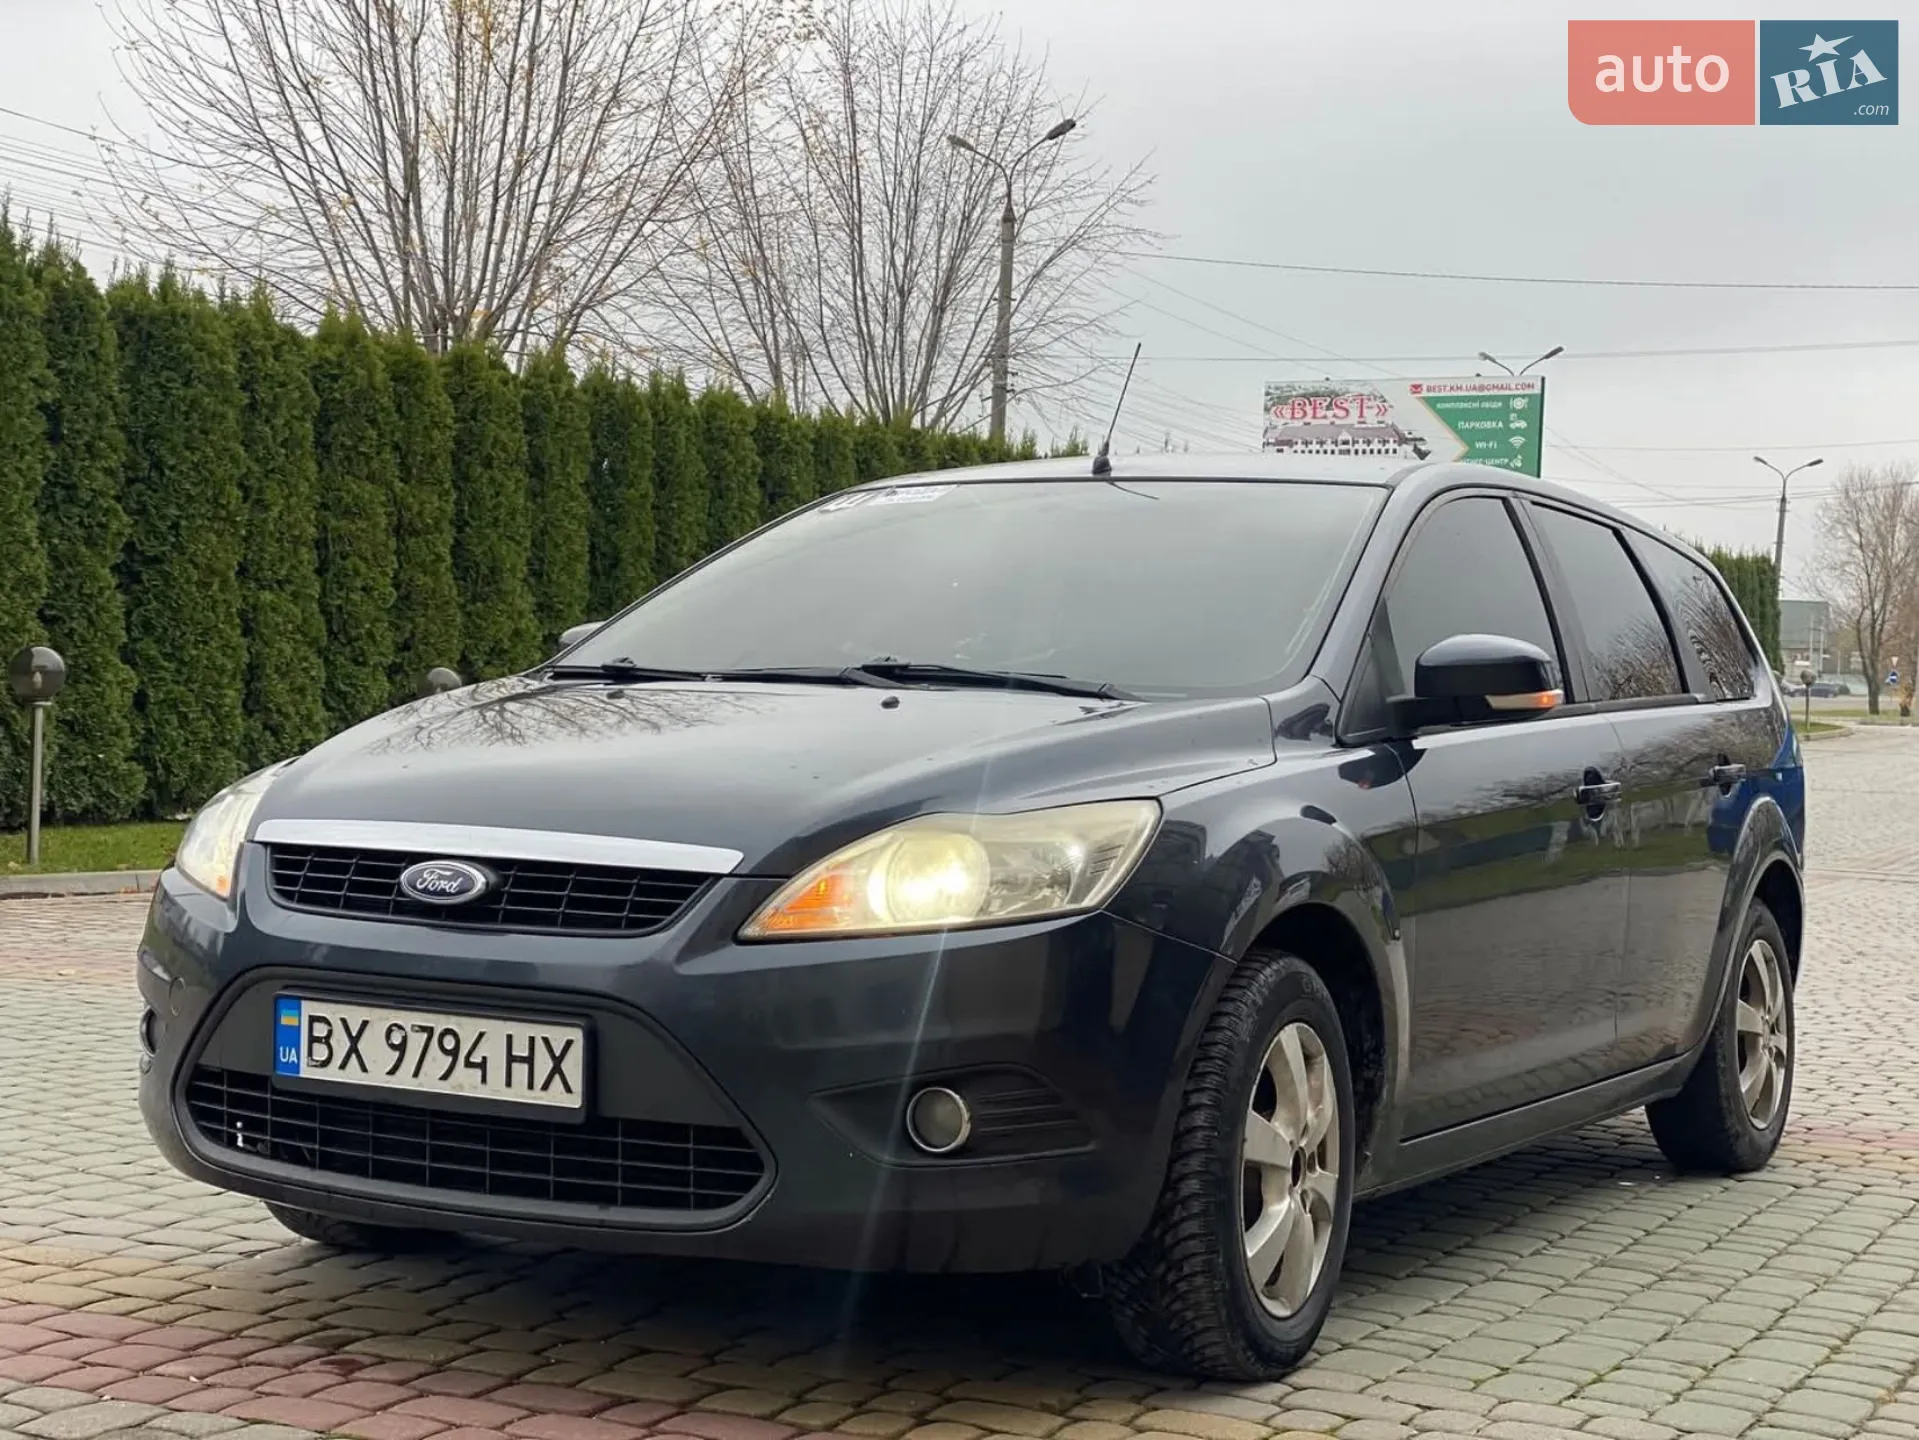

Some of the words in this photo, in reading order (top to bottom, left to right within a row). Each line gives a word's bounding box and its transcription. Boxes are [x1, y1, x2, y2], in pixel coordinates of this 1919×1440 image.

[1426, 383, 1535, 393] BEST.KM.UA@GMAIL.COM
[1458, 420, 1504, 429] ПАРКОВКА
[416, 868, 463, 894] Ford
[279, 1047, 298, 1064] UA
[306, 1014, 370, 1074] BX
[384, 1022, 488, 1085] 9794
[504, 1033, 575, 1094] HX
